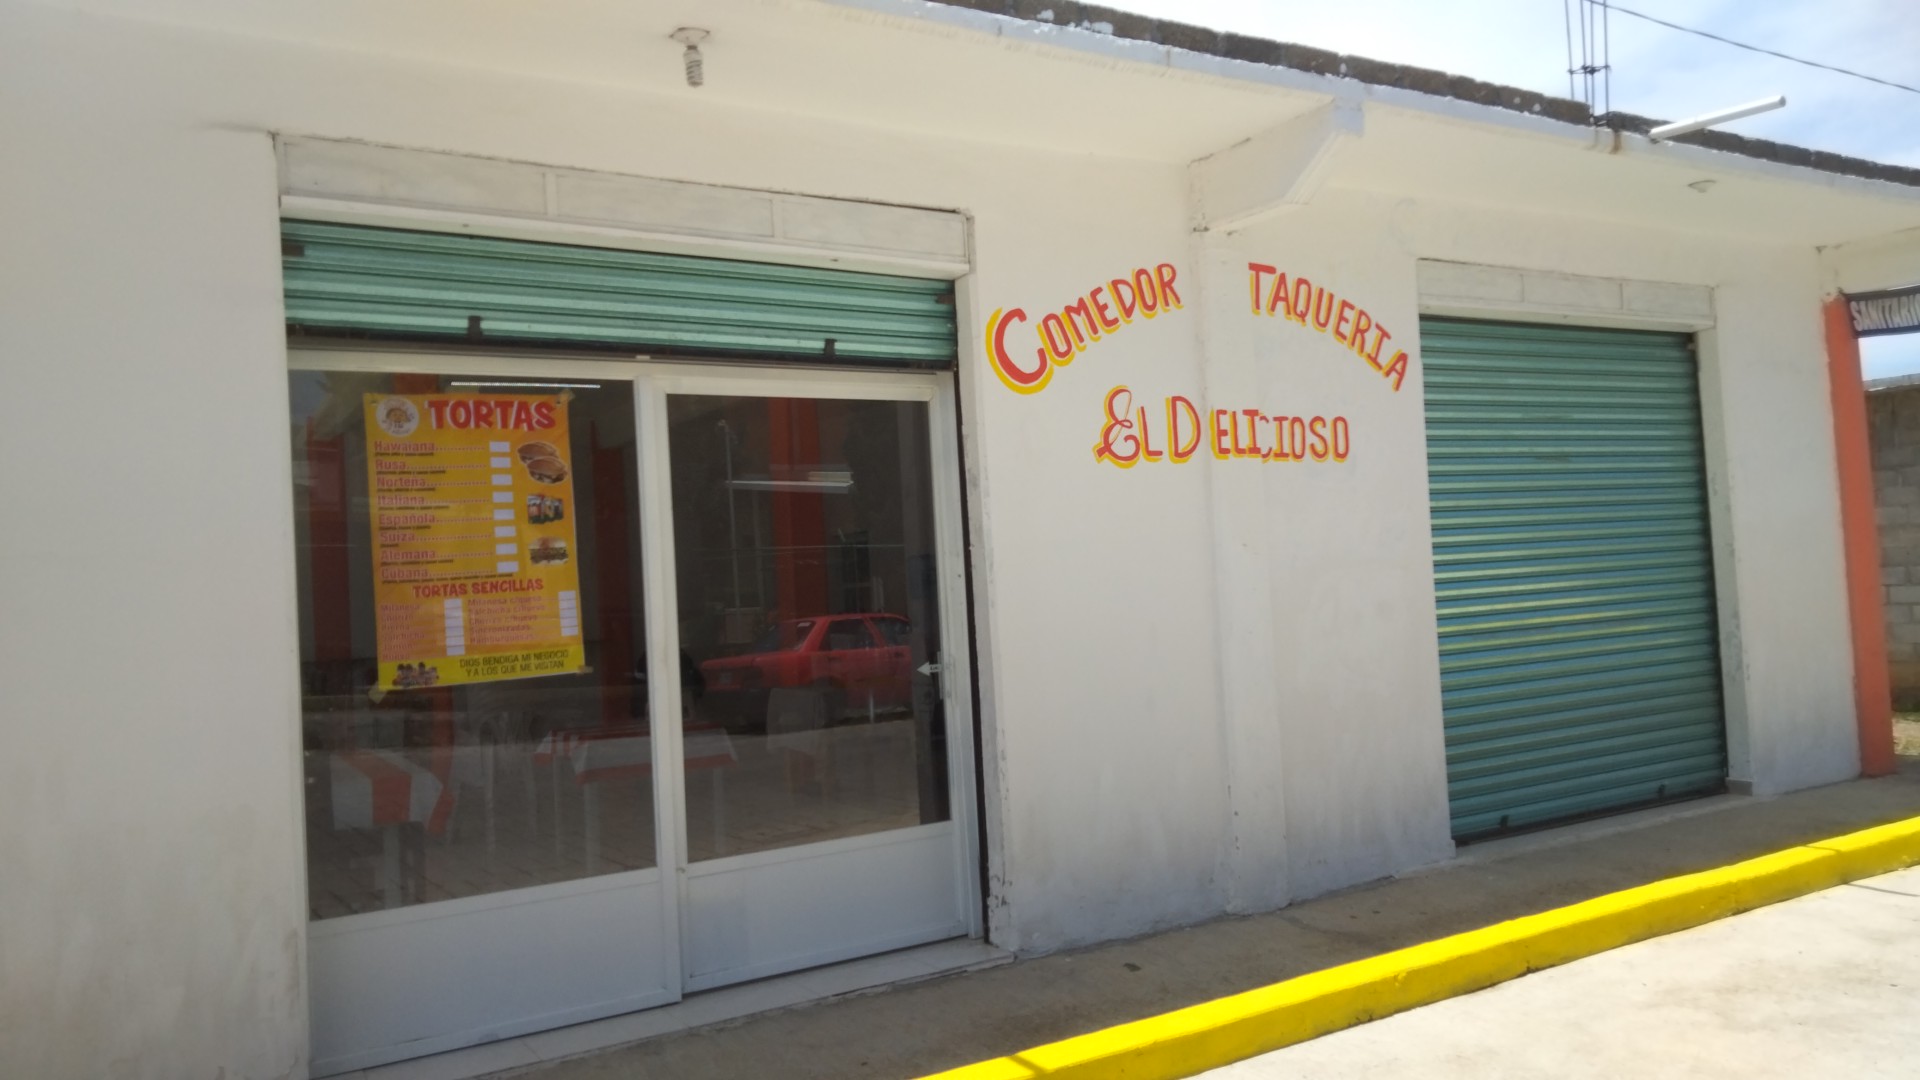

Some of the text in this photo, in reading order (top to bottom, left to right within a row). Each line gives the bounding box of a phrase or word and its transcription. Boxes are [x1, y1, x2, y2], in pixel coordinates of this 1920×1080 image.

[1849, 293, 1920, 331] SANITARI
[986, 262, 1409, 395] COMEDOR TAQUERIA
[425, 399, 557, 431] TORTAS
[374, 441, 435, 452] Hawaiana
[375, 459, 406, 470] Rusa
[378, 495, 424, 505] Italiana
[379, 513, 435, 525] Española
[380, 532, 415, 542] Suiza
[381, 550, 436, 560] Alemana
[382, 569, 428, 579] Cubana
[413, 583, 467, 598] TORTAS
[471, 578, 544, 595] SENCILLAS
[459, 650, 569, 669] DIOS BENDIGA MI NEGOCIO
[465, 660, 564, 678] Y A LOS QUE ME VISITAN
